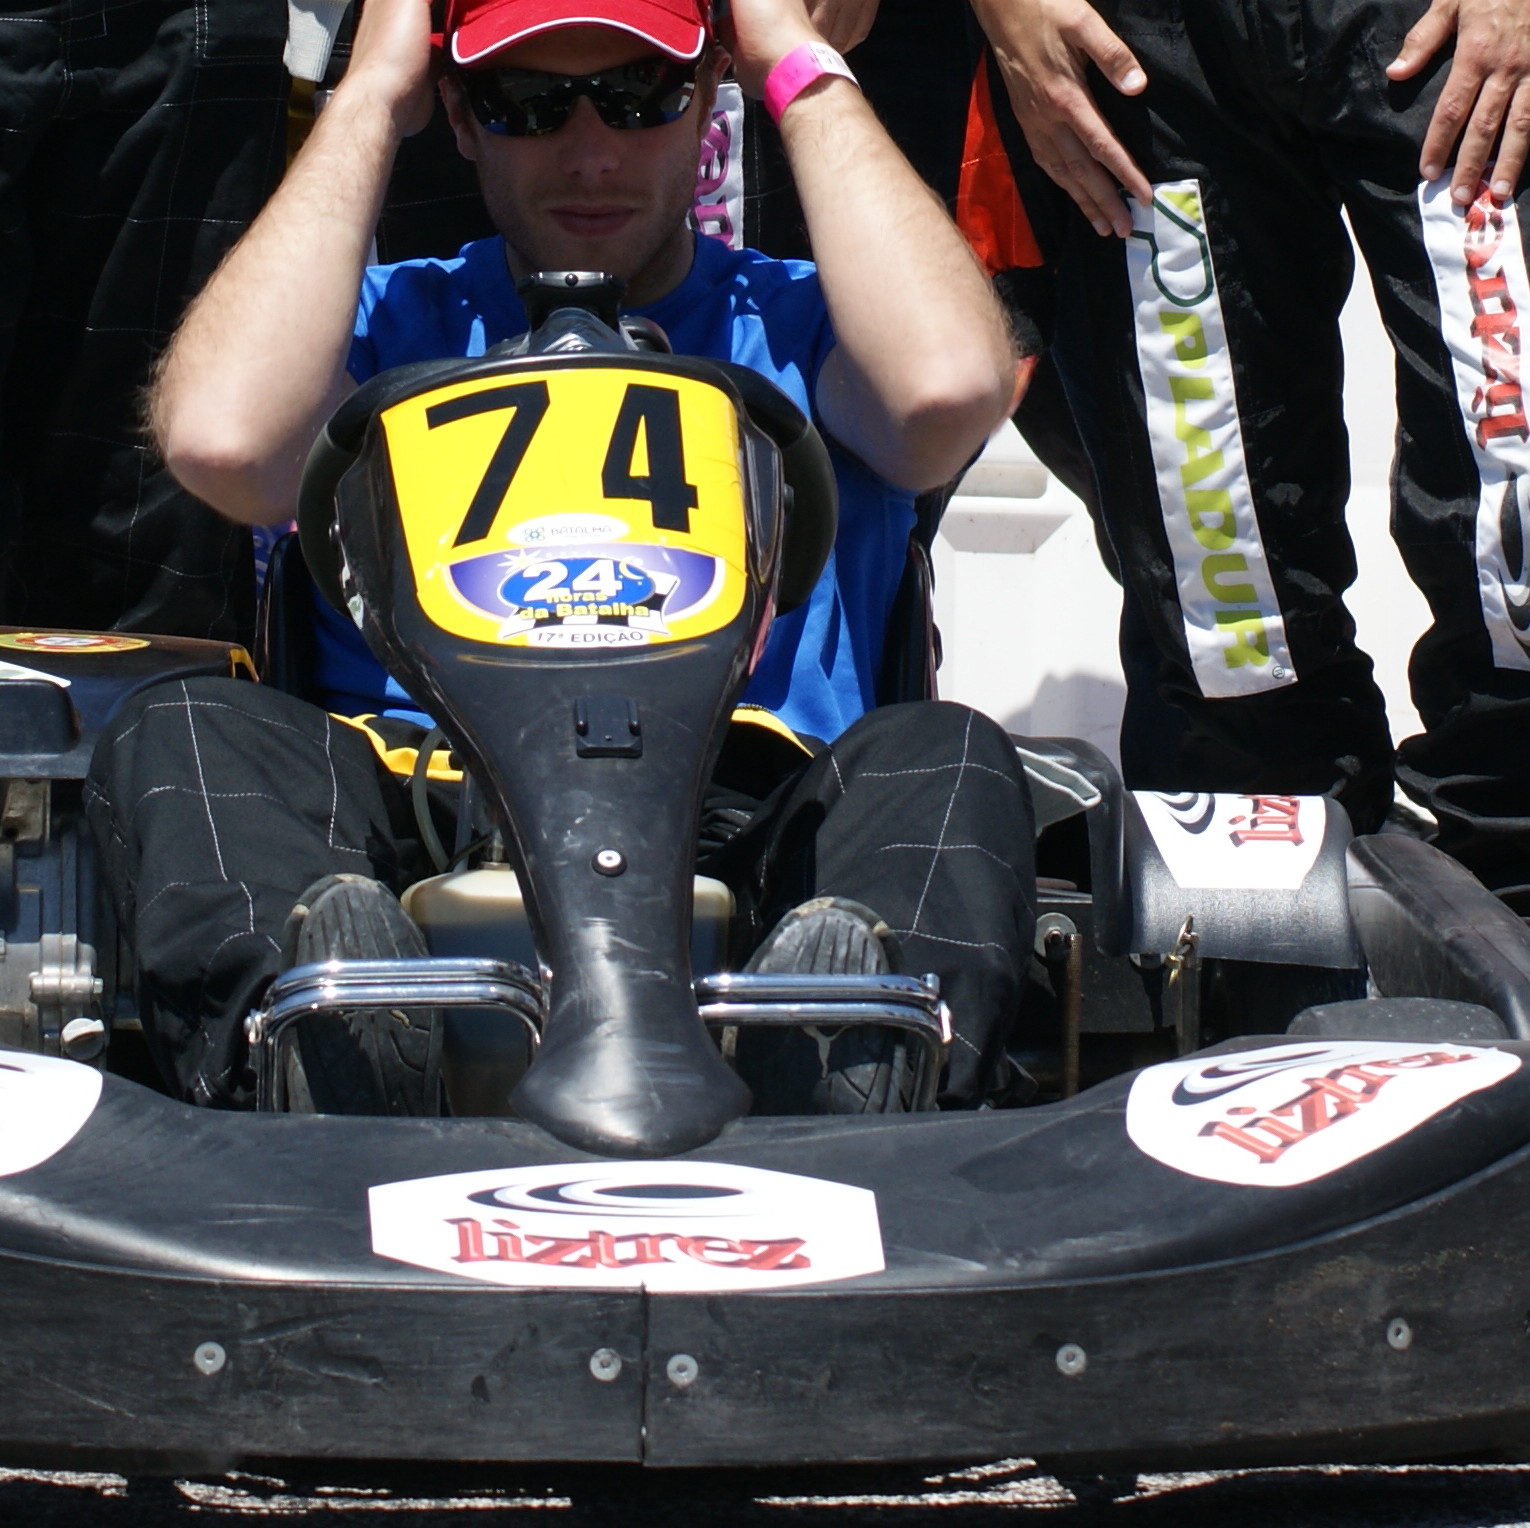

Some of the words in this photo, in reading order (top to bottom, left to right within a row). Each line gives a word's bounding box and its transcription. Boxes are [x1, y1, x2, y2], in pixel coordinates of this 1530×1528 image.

[1158, 312, 1270, 669] PLADUR
[522, 560, 623, 602] 24
[546, 589, 608, 604] horas
[519, 606, 550, 621] da
[556, 601, 651, 619] Batalha
[570, 628, 644, 645] EDIÇÃO
[1197, 1052, 1479, 1164] liztrez
[444, 1217, 811, 1271] liztrez
